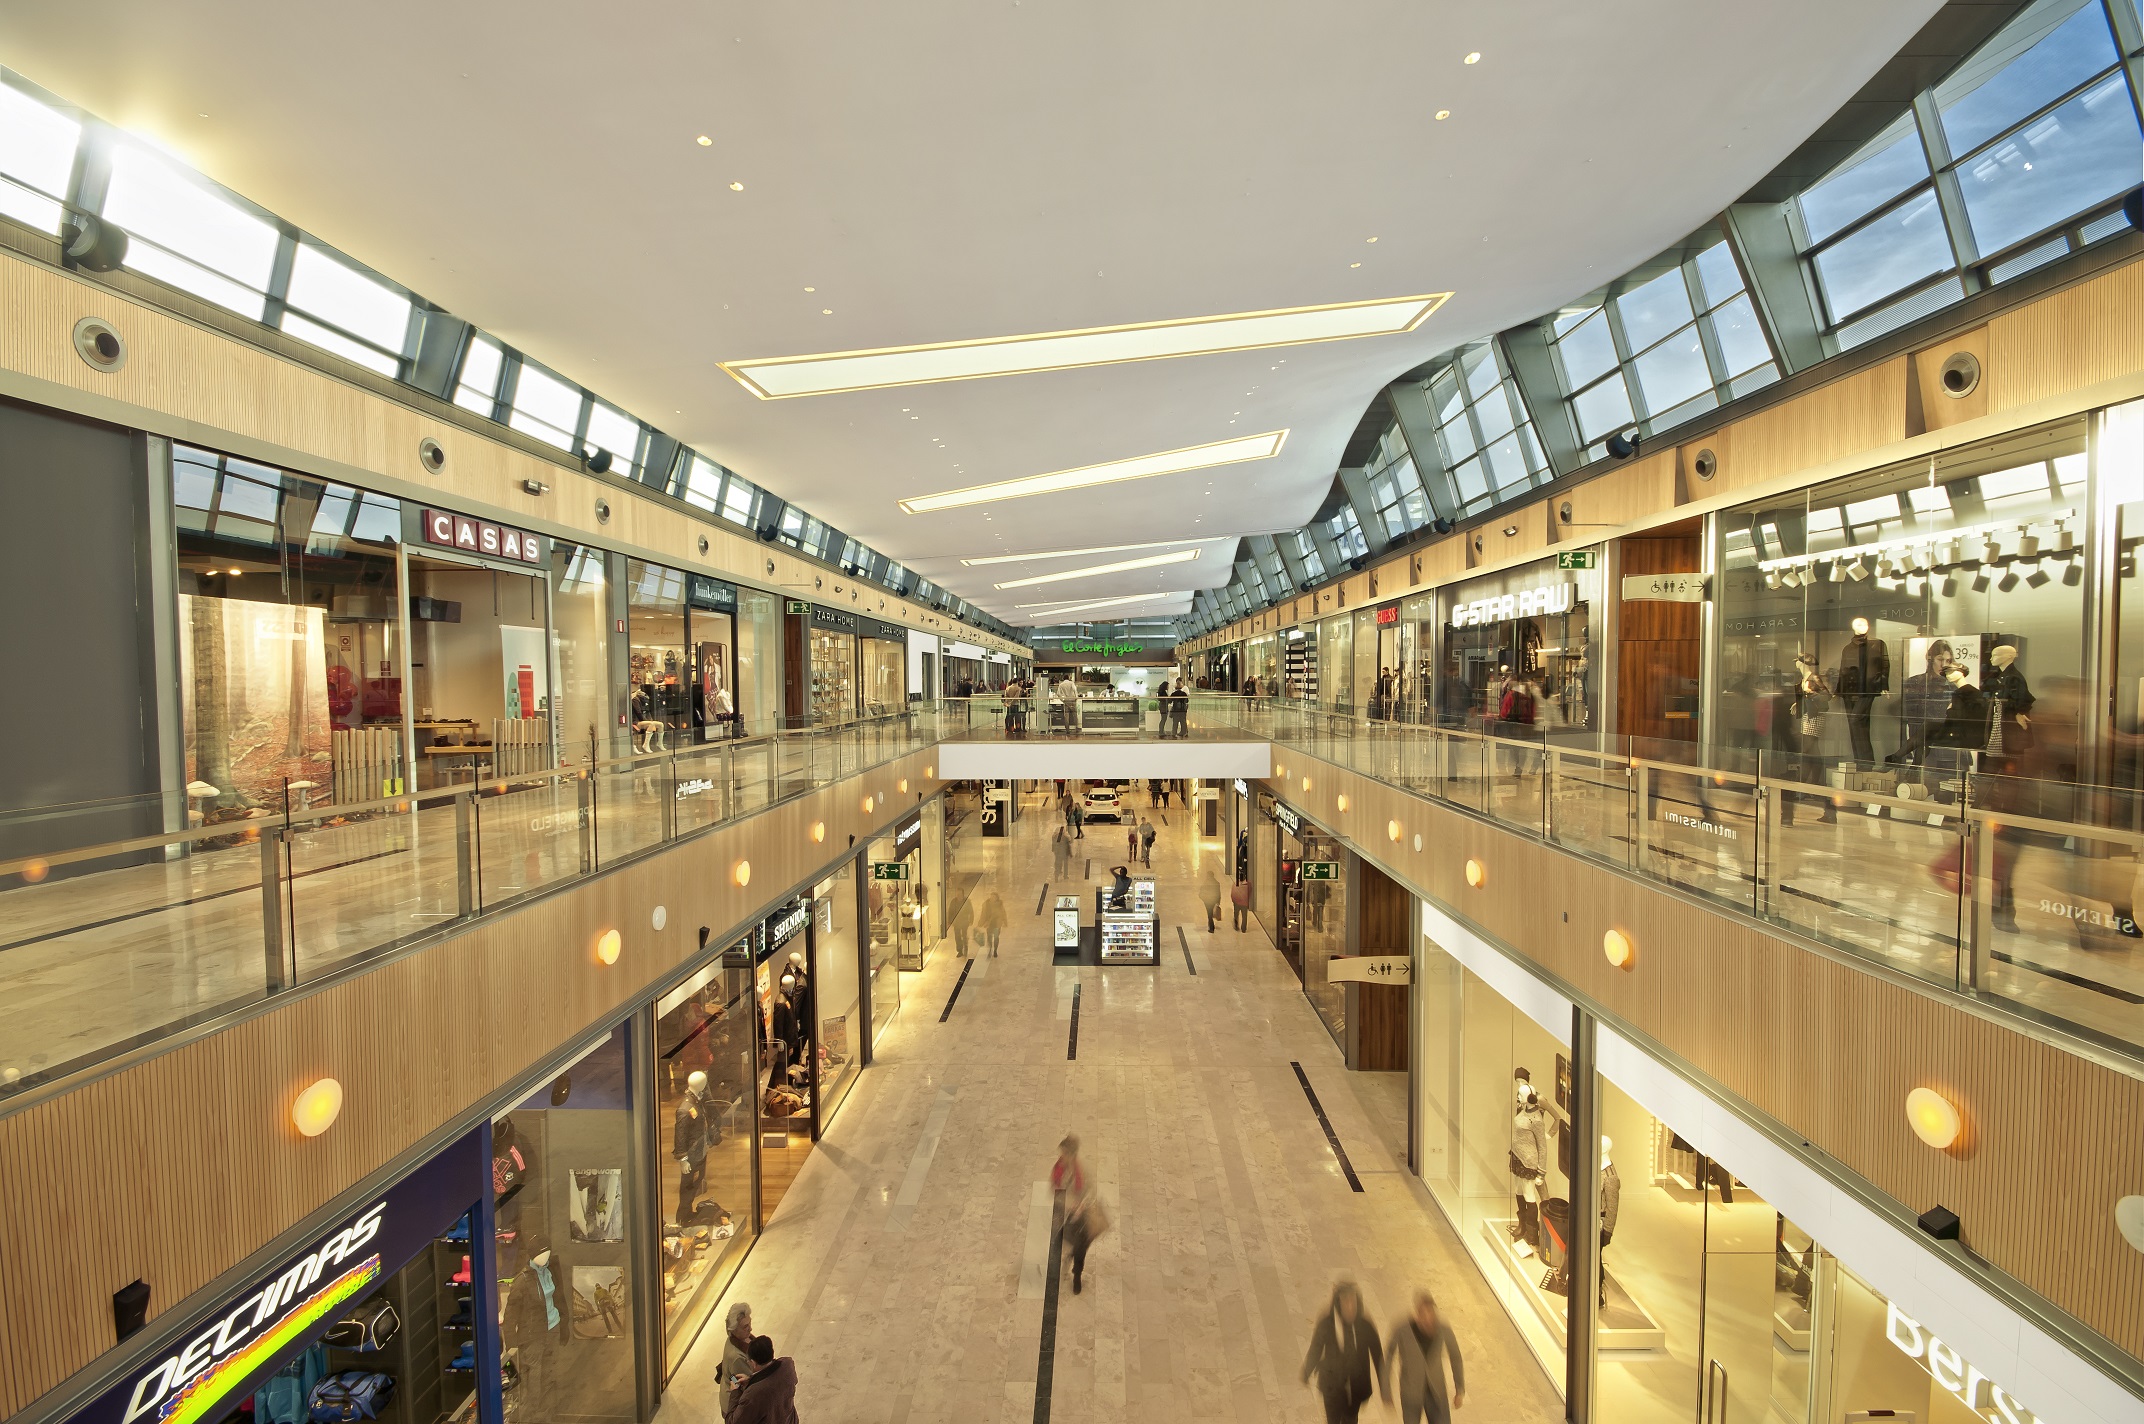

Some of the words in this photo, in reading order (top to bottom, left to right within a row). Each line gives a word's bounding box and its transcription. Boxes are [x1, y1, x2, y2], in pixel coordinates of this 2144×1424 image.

[433, 516, 538, 559] CASAS
[816, 610, 835, 623] ZARA
[837, 615, 854, 627] HOME
[1376, 607, 1397, 624] GUESS
[1452, 593, 1514, 628] G-STAR
[1519, 582, 1570, 617] RAW
[880, 625, 893, 635] ZARA
[893, 628, 905, 638] HOME
[1062, 639, 1075, 652] El
[1075, 639, 1102, 653] Corte
[1103, 637, 1143, 657] Inglés
[774, 906, 806, 942] SHENIOR
[122, 1201, 387, 1424] DECIMAS
